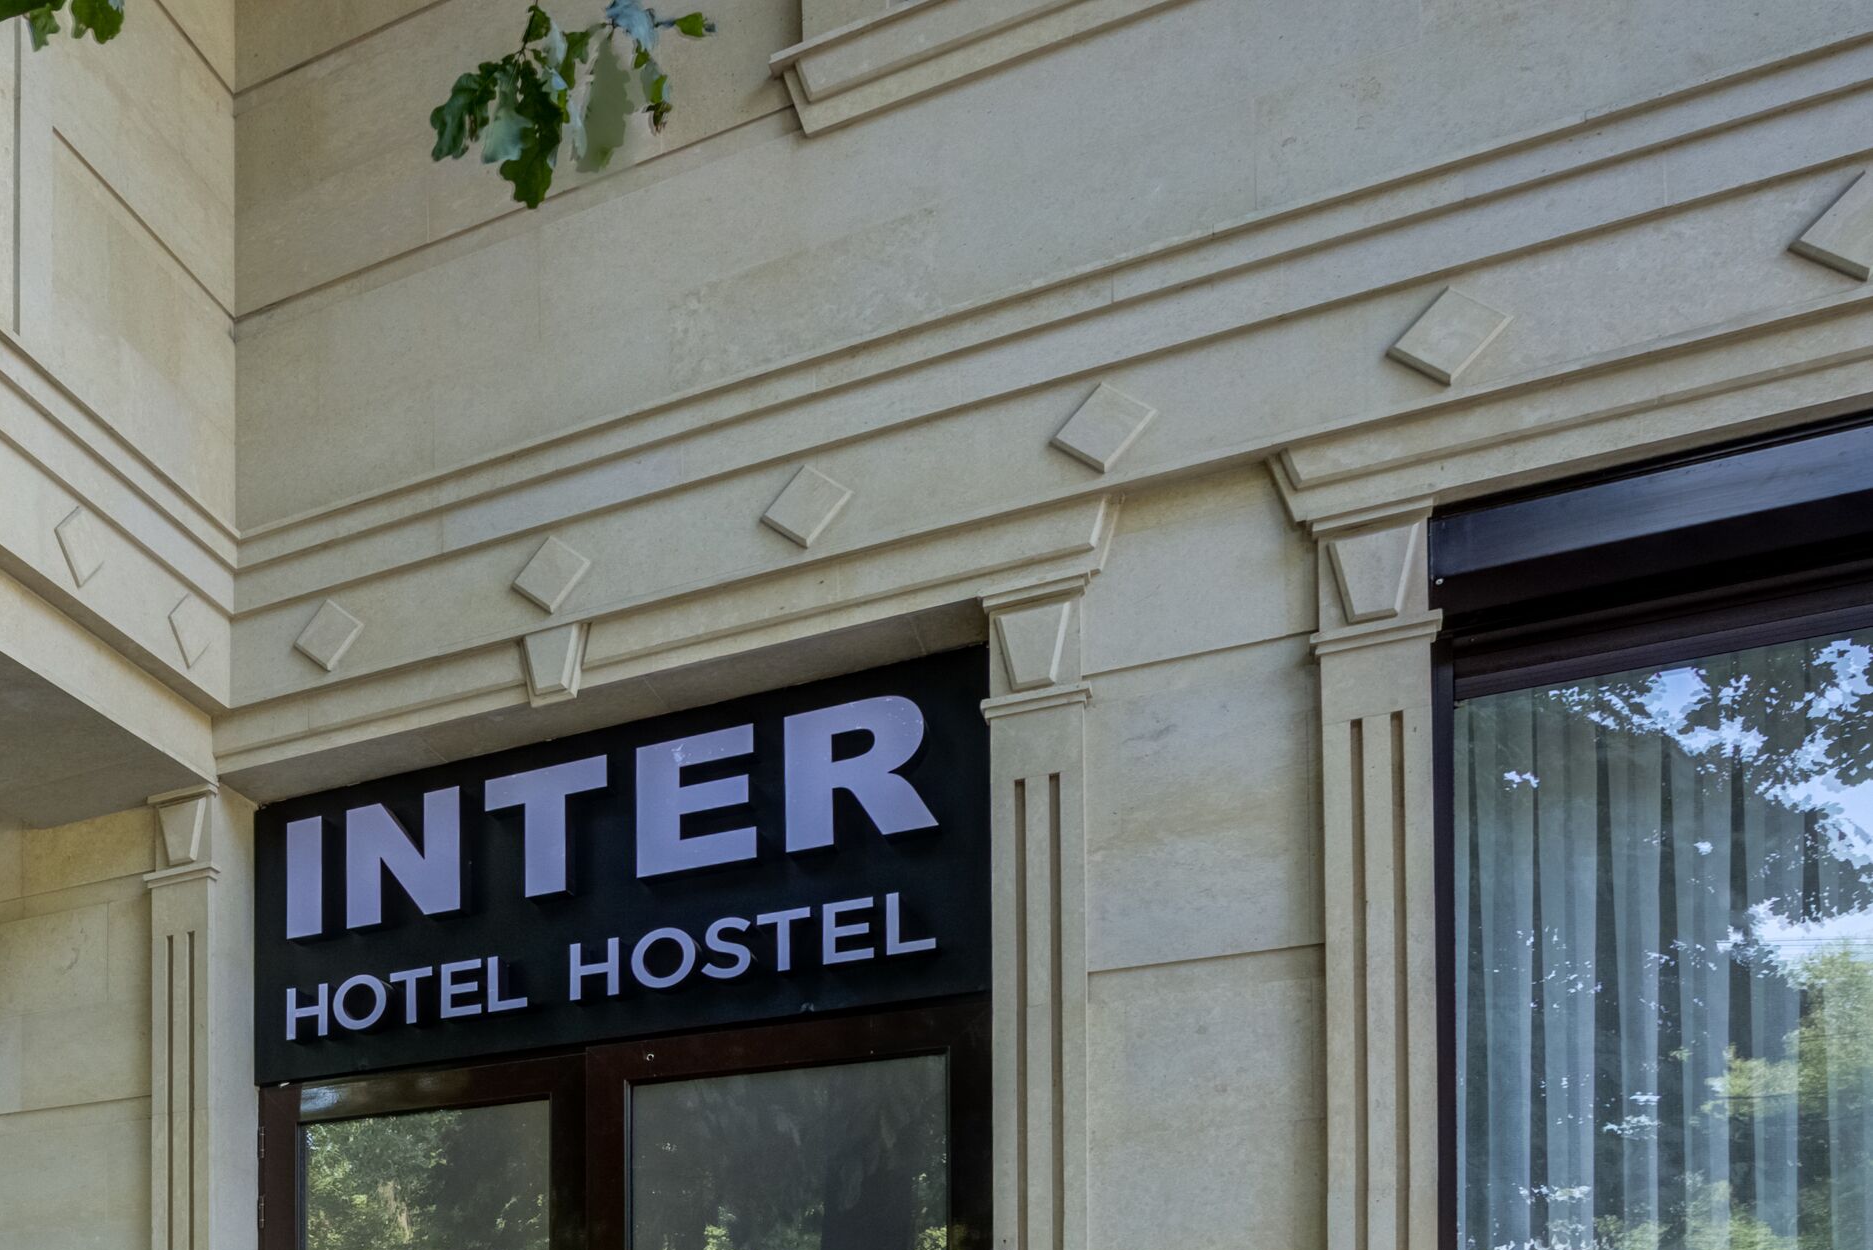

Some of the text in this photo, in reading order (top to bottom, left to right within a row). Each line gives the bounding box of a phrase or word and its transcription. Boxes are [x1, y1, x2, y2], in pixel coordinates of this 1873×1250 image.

[286, 695, 939, 940] INTER
[286, 892, 937, 1041] HOTEL HOSTEL
